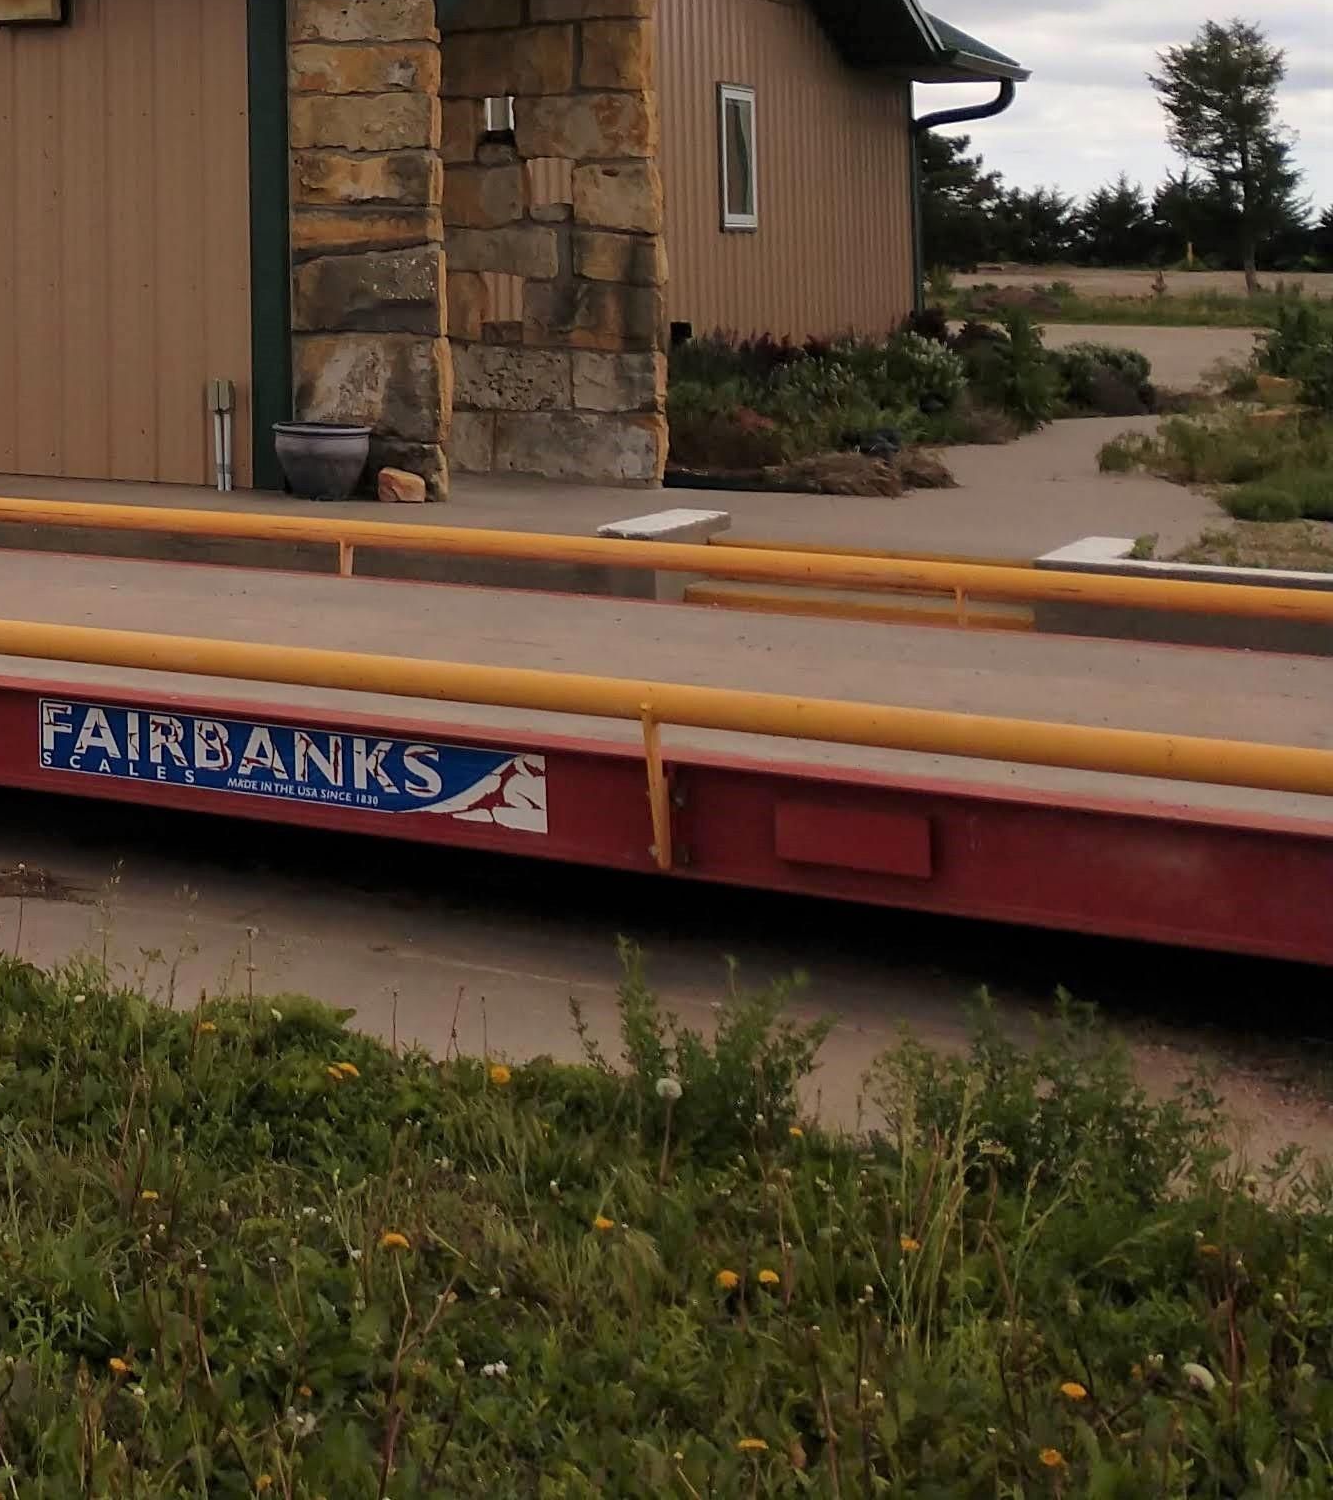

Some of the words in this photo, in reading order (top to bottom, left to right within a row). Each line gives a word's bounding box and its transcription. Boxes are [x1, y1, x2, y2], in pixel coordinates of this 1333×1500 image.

[42, 702, 443, 798] FAIRBANKS
[42, 751, 195, 784] SCALES
[227, 777, 257, 789] MADE
[260, 781, 273, 791] IN
[274, 783, 295, 795] THE
[297, 786, 318, 798] USA
[319, 789, 352, 802] SINCE
[355, 793, 379, 806] 1830
